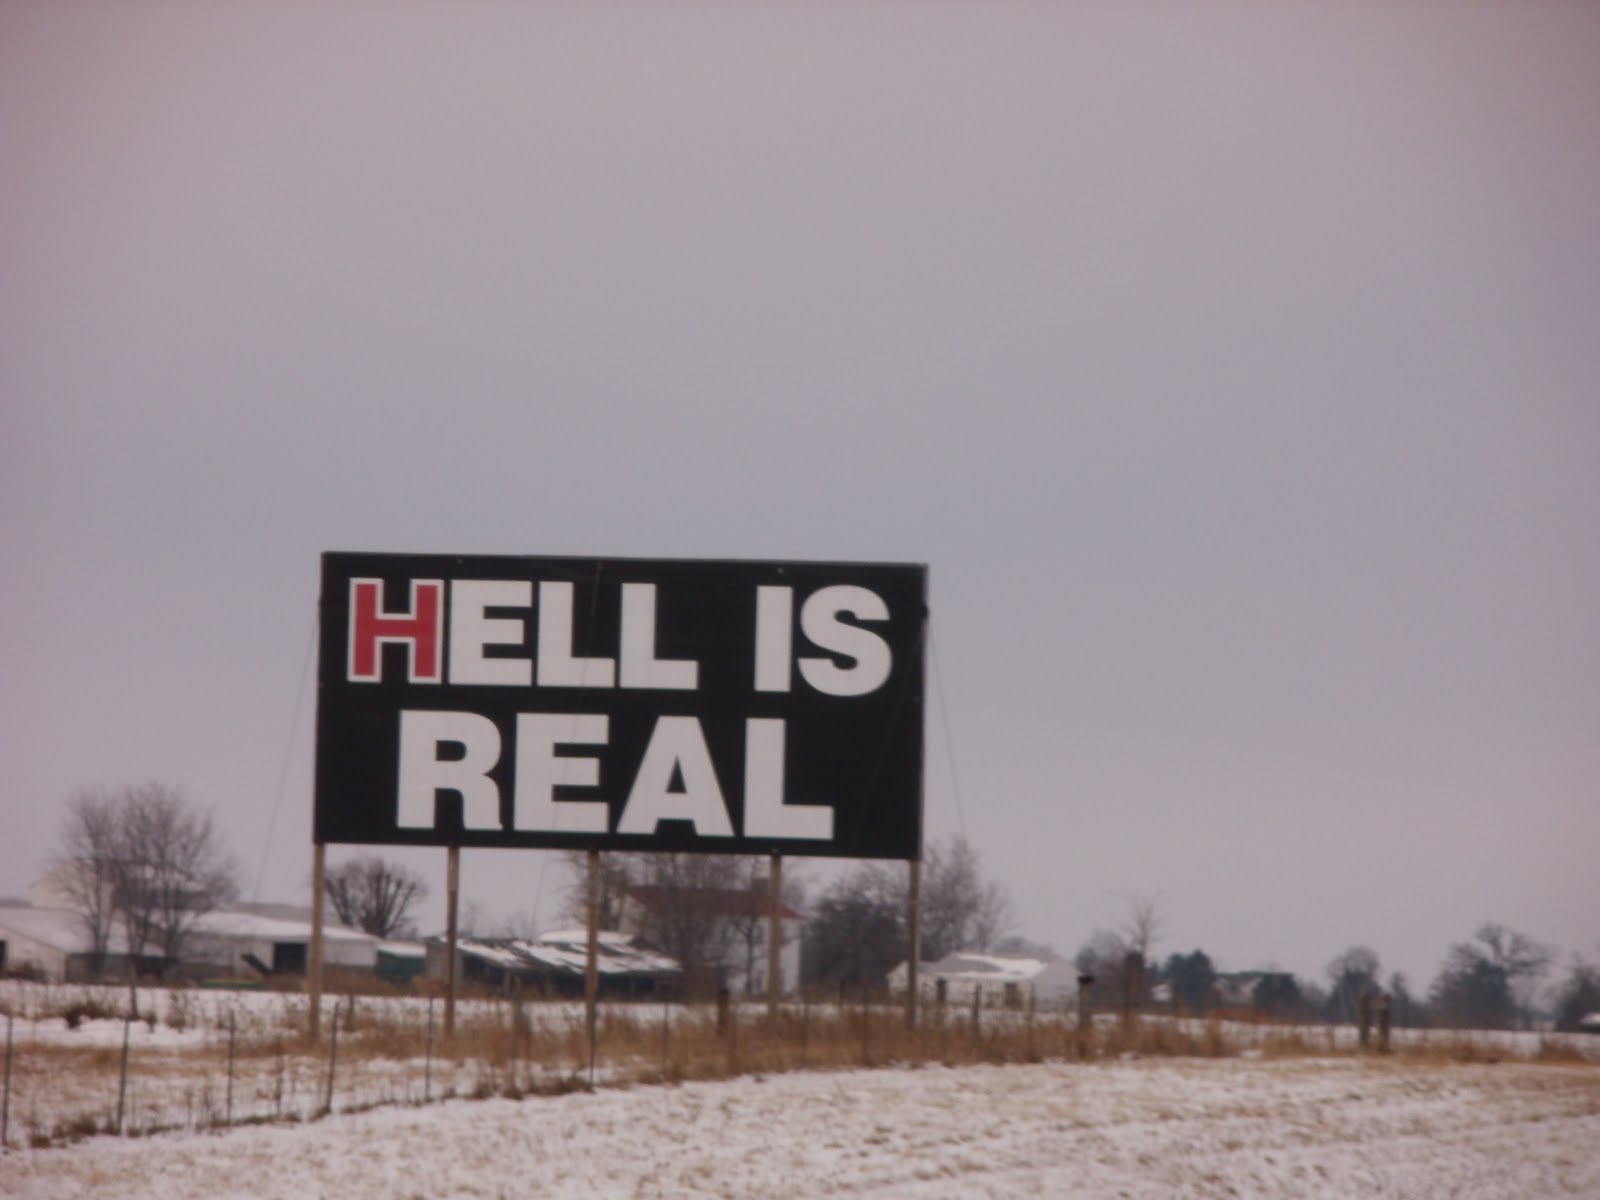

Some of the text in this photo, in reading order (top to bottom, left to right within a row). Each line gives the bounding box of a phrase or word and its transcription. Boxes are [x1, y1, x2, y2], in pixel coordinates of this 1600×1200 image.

[347, 577, 892, 697] HELL IS
[396, 709, 834, 840] REAL
